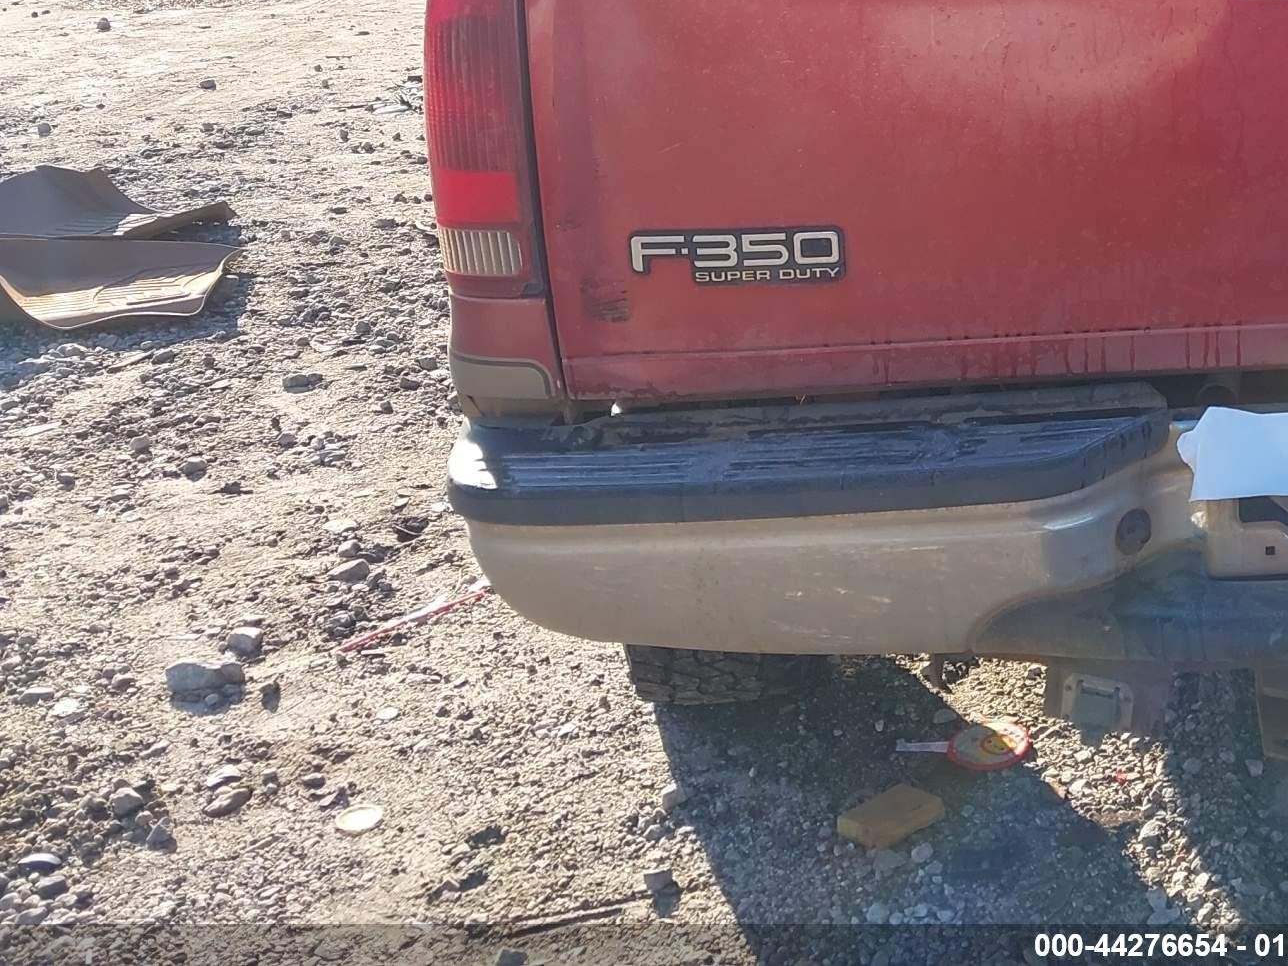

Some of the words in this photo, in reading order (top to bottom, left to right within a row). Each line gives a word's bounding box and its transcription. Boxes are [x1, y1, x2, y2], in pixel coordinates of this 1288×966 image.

[630, 230, 840, 273] F-350
[695, 270, 771, 282] SUPER
[779, 266, 840, 280] DUTY
